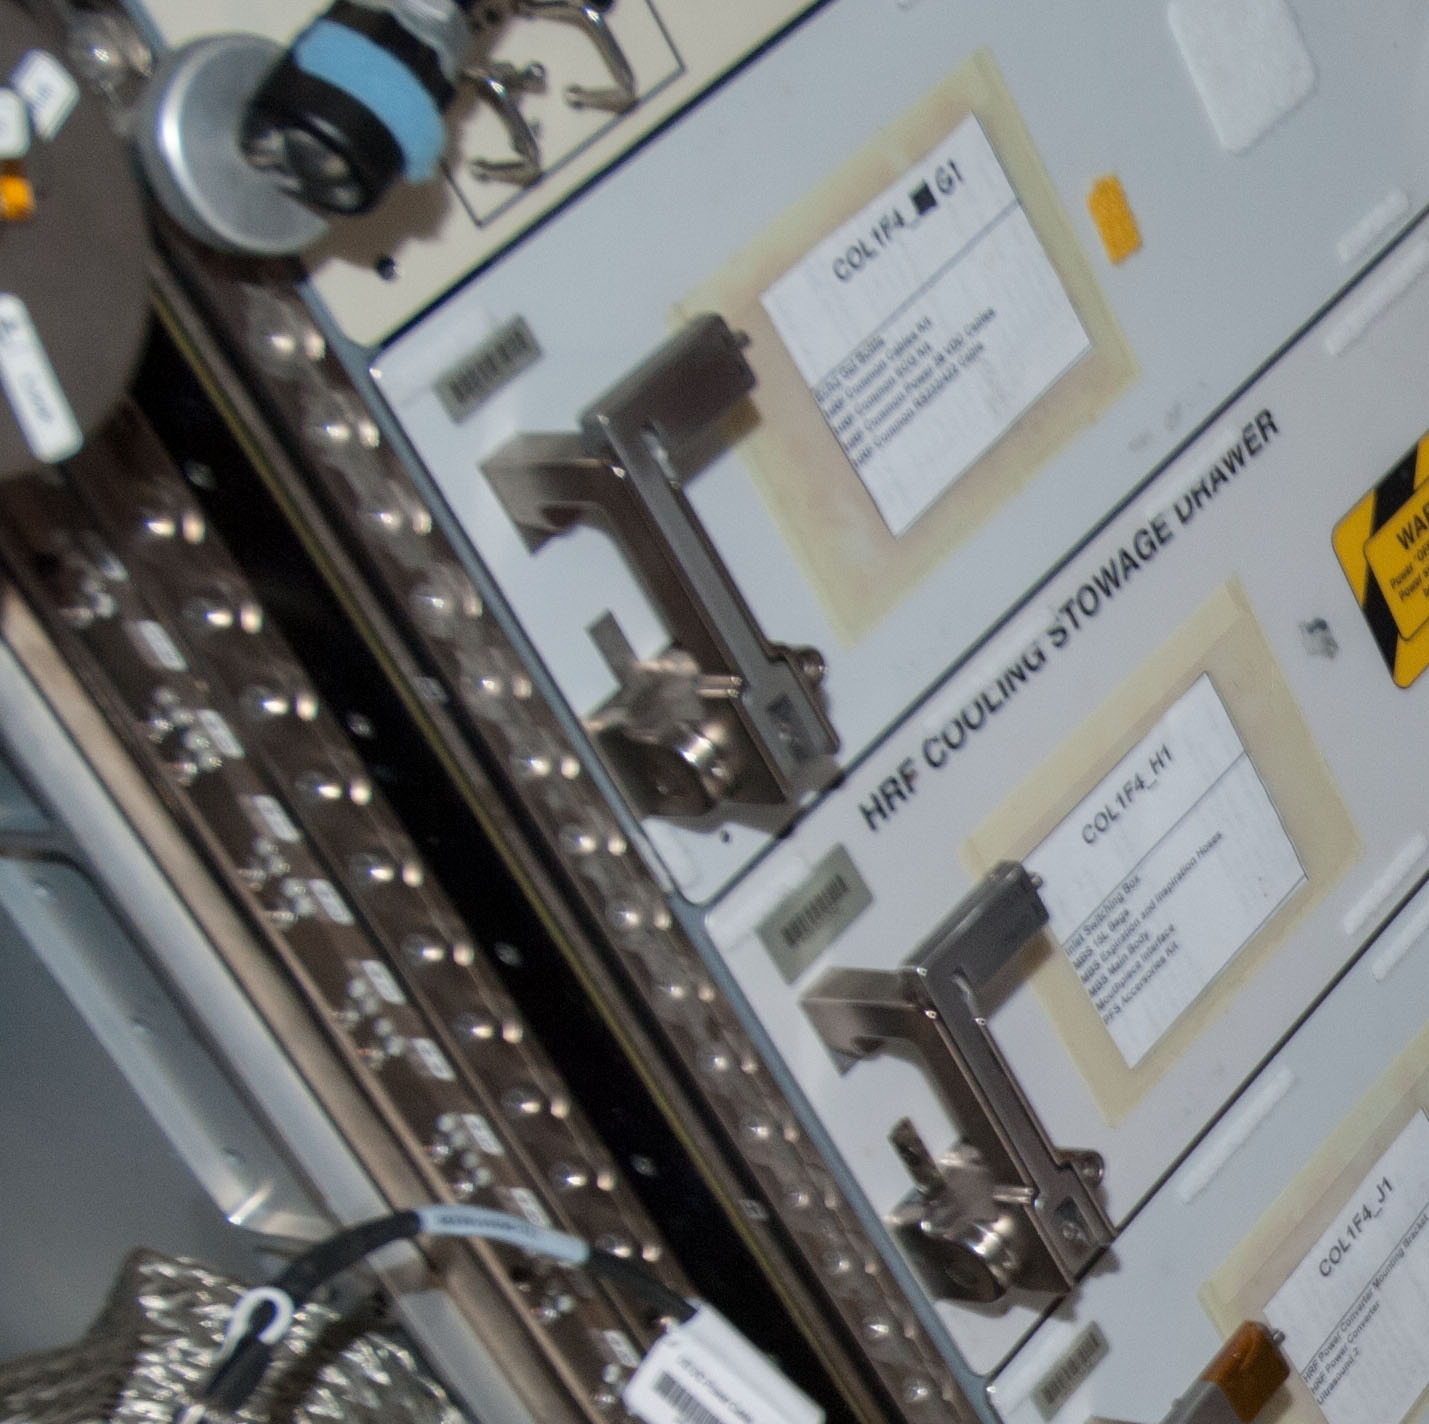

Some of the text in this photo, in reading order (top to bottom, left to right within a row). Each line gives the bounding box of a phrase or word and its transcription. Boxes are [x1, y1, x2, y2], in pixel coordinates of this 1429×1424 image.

[1388, 559, 1414, 591] Power
[1398, 572, 1422, 602] Power
[856, 757, 925, 835] HRF
[1039, 508, 1176, 652] STOWAGE
[1079, 742, 1175, 851] COL1F4_H1
[1081, 888, 1125, 939] Switching
[1121, 870, 1140, 895] Box
[1098, 916, 1141, 965] Expiration
[1139, 898, 1156, 920] and
[1154, 854, 1198, 905] Inspiration
[1126, 928, 1150, 957] Body
[1164, 938, 1179, 958] Kit
[1315, 1174, 1395, 1282] COL1F4_J1
[1302, 1210, 1429, 1384] HRF Power Converter Mounting Bracket
[1309, 1297, 1381, 1396] HRF Power Converter
[1315, 1352, 1355, 1407] Ultrasound
